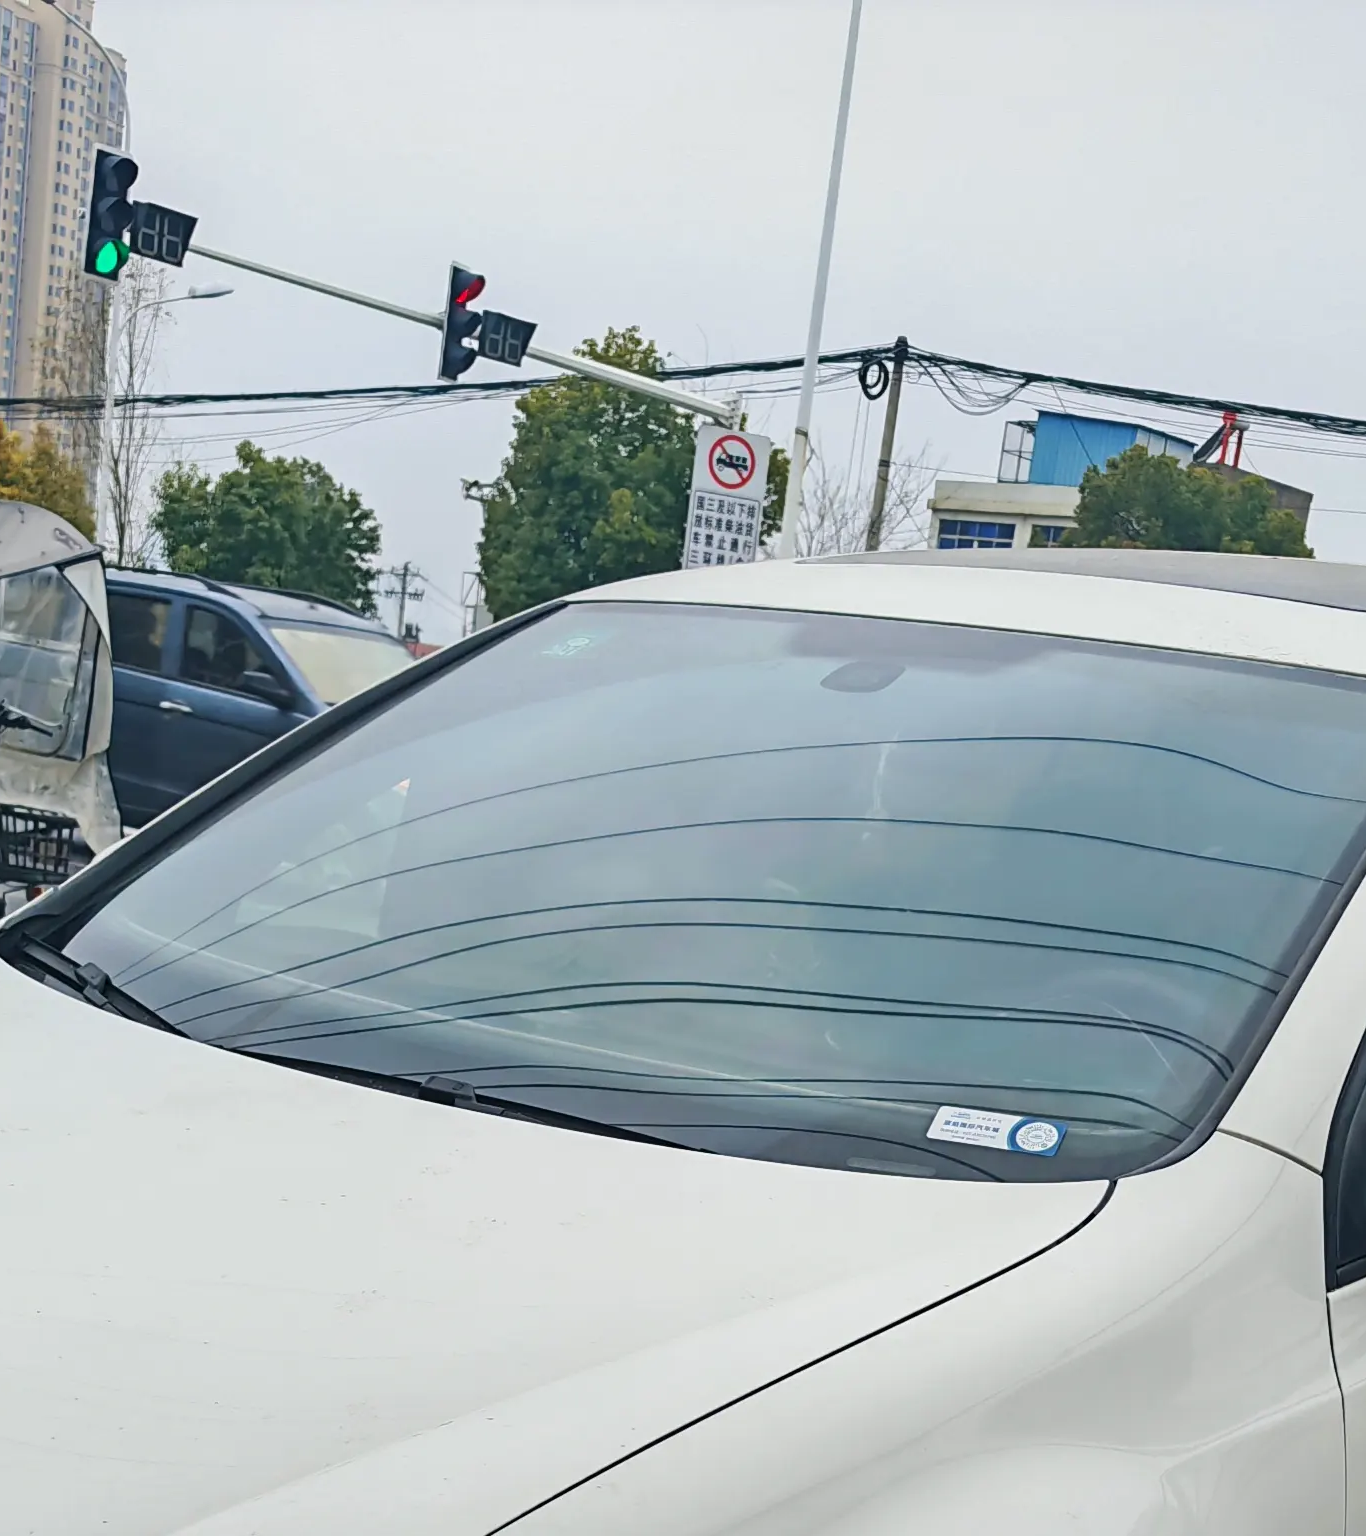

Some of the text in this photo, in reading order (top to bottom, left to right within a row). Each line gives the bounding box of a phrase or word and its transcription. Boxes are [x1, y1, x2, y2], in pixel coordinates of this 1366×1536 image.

[692, 532, 752, 556] 车禁止通行
